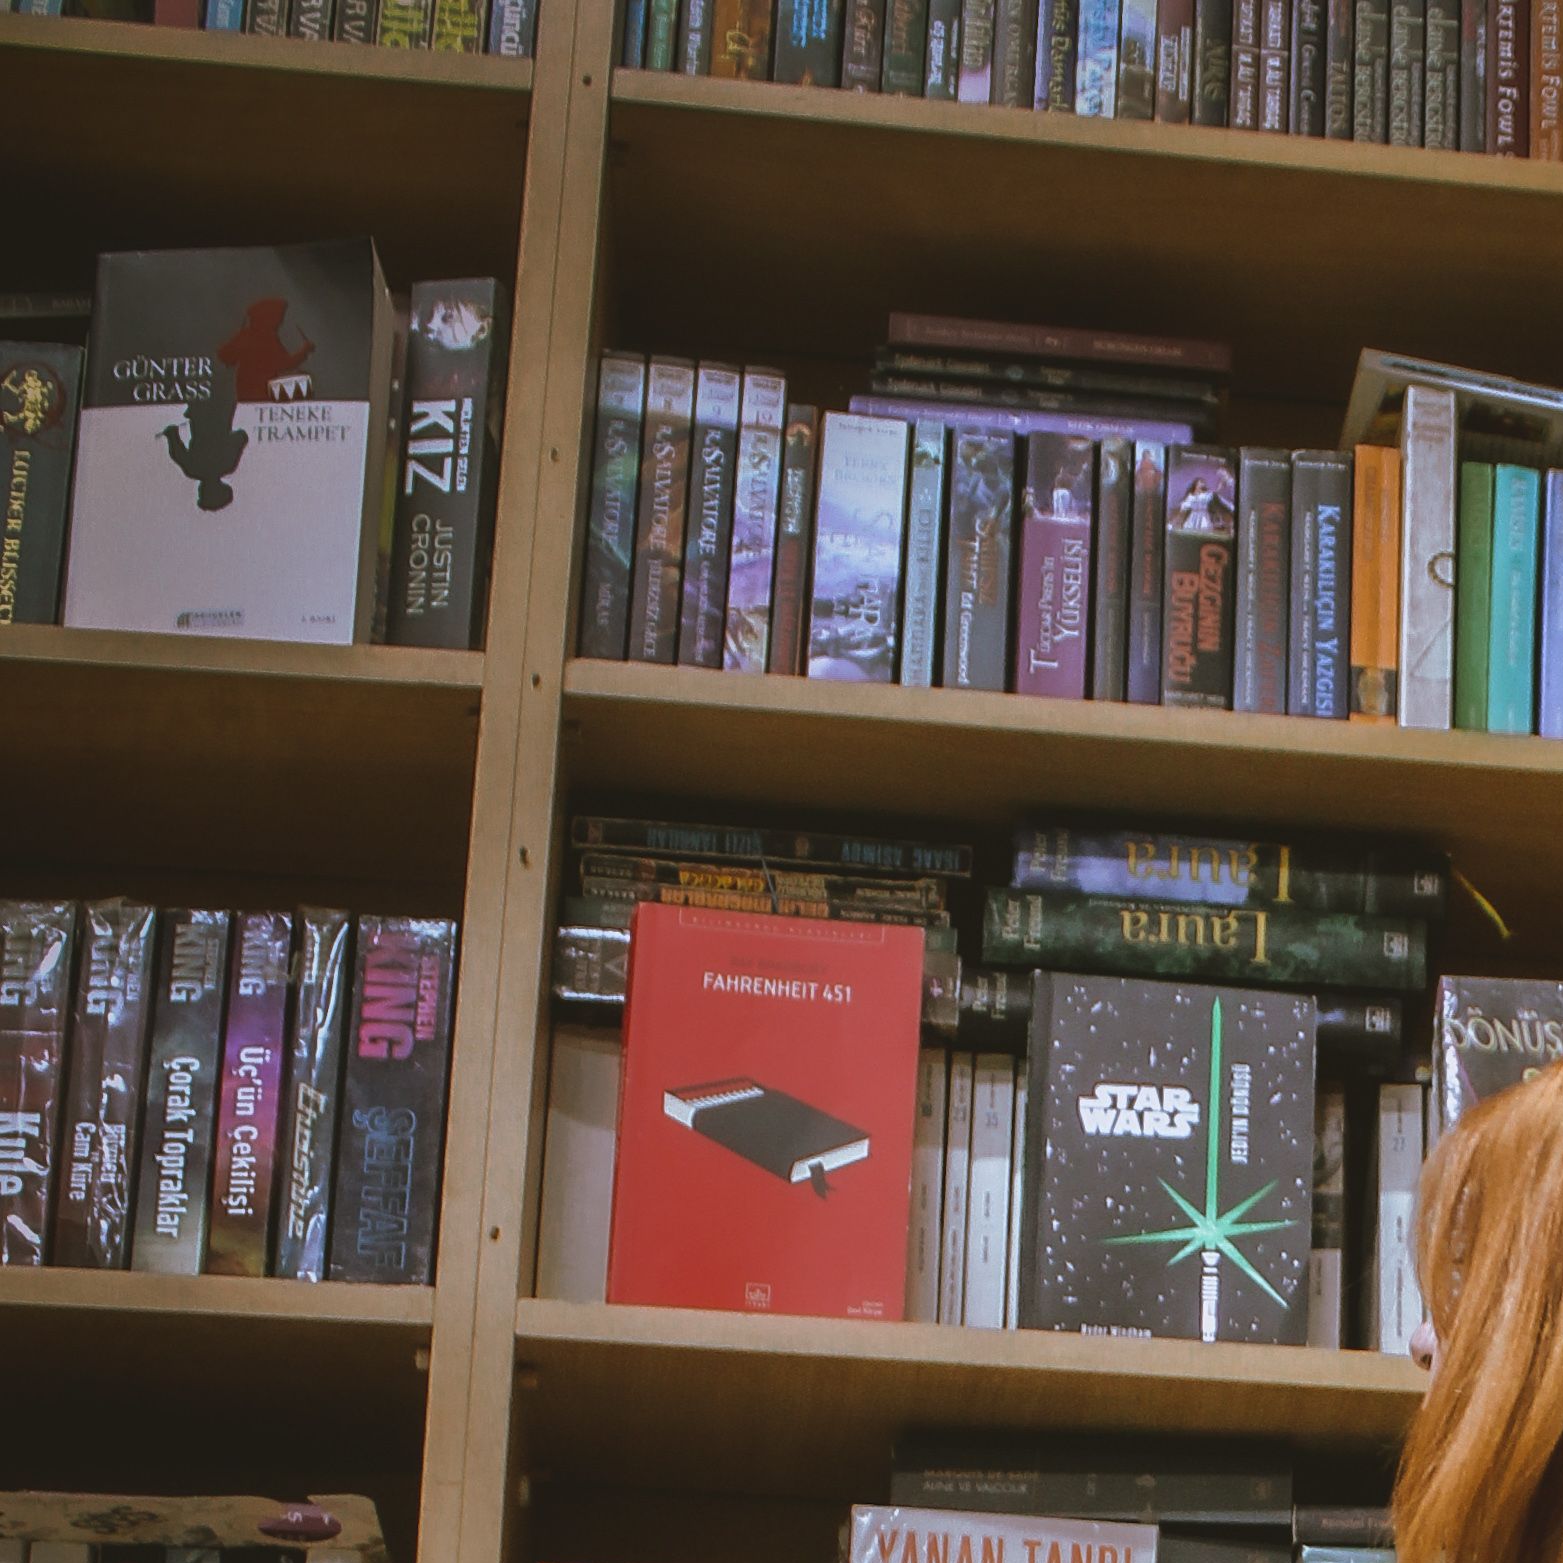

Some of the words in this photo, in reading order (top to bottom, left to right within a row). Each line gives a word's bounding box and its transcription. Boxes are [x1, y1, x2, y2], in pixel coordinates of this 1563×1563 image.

[112, 354, 214, 381] GÜNTER
[133, 380, 212, 402] GRASS
[253, 425, 352, 444] TRAMPET
[254, 405, 333, 424] TENEKE
[402, 398, 457, 497] KIZ
[405, 514, 431, 615] CRONIN
[432, 519, 454, 609] JUSTIN
[1125, 840, 1294, 903] Laura
[1119, 909, 1271, 967] Laura
[357, 927, 416, 1061] KING
[701, 971, 820, 1001] FAHRENHEIT
[822, 984, 853, 1004] 451
[163, 1055, 200, 1124] Çorak
[1090, 1081, 1201, 1112] STAR
[1079, 1102, 1200, 1140] WARS
[154, 1128, 194, 1240] Topraklar
[219, 1122, 260, 1218] Çekilişi
